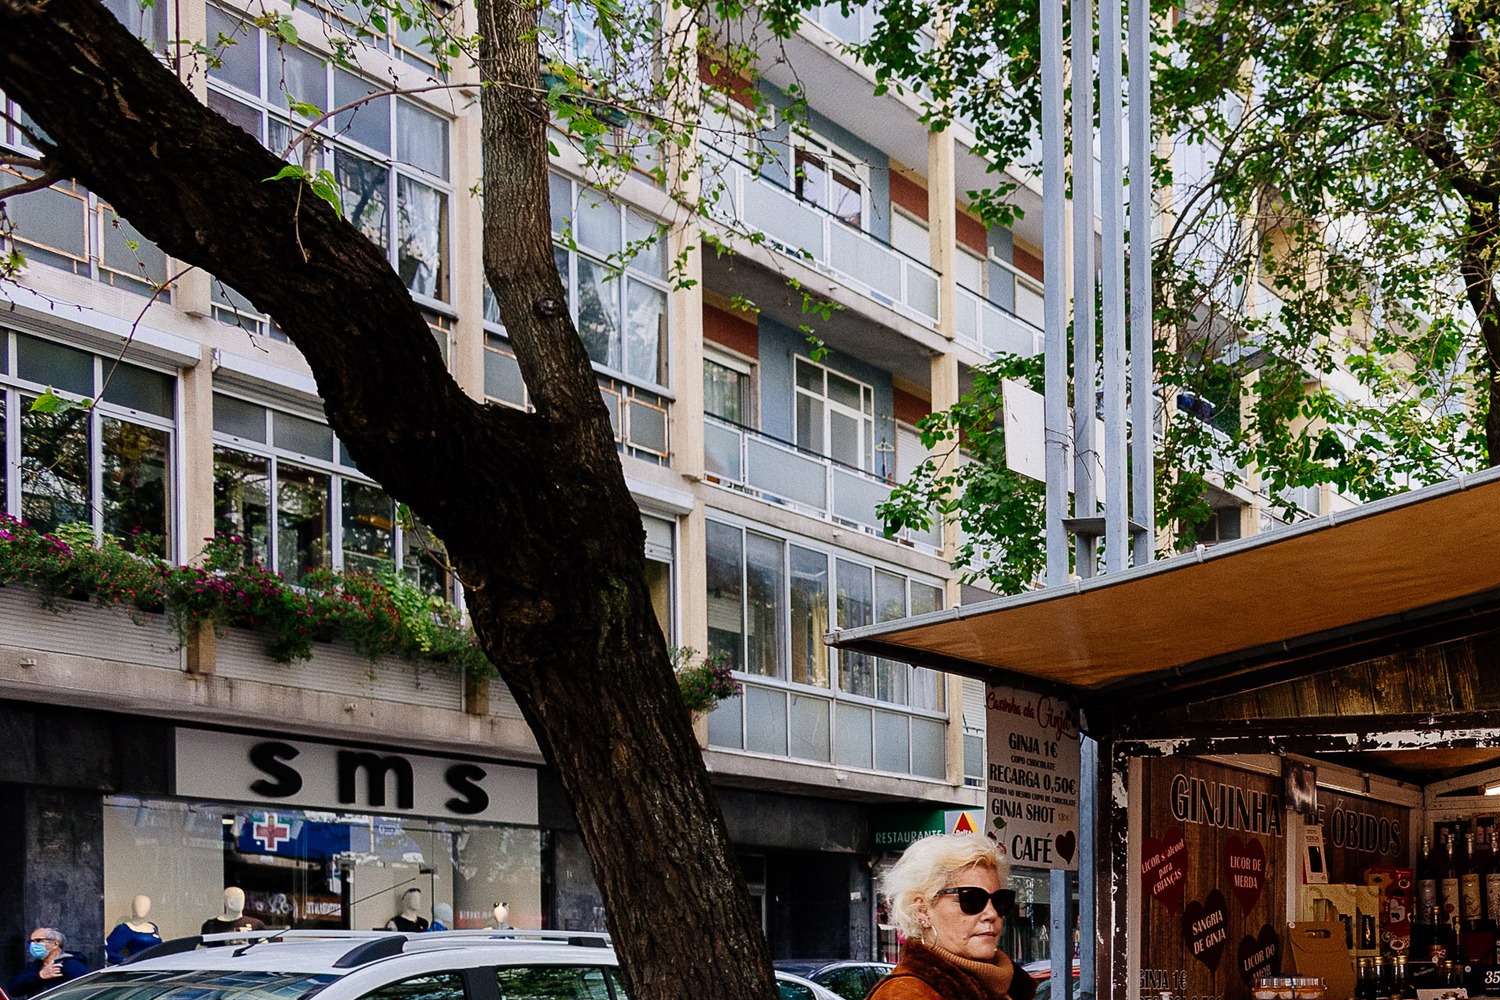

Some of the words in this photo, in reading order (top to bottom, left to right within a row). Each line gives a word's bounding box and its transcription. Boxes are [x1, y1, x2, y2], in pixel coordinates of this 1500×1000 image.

[1009, 732, 1040, 755] GINJA
[1044, 740, 1058, 758] 1€
[1026, 757, 1056, 771] CHOCOLATE
[249, 740, 490, 815] sms
[990, 763, 1041, 789] RECARGA
[1043, 774, 1076, 795] 0,50€
[992, 798, 1023, 820] GINJA
[1026, 804, 1056, 824] SHOT
[1170, 773, 1283, 838] GINJINHA
[1331, 798, 1401, 857] ÓBIDOS
[1012, 832, 1053, 864] CAFÉ
[1141, 856, 1161, 874] LICOR
[1158, 862, 1174, 879] para
[1230, 855, 1251, 871] LICOR
[1252, 858, 1262, 872] DE
[1153, 869, 1183, 895] CRIANÇAS
[1234, 874, 1258, 890] MERDA
[1191, 910, 1224, 937] SANGRIA
[1194, 938, 1205, 955] DE
[1205, 927, 1227, 949] GINJA
[1243, 950, 1265, 972] LICOR
[1265, 943, 1276, 957] DO
[1173, 969, 1188, 990] 1€
